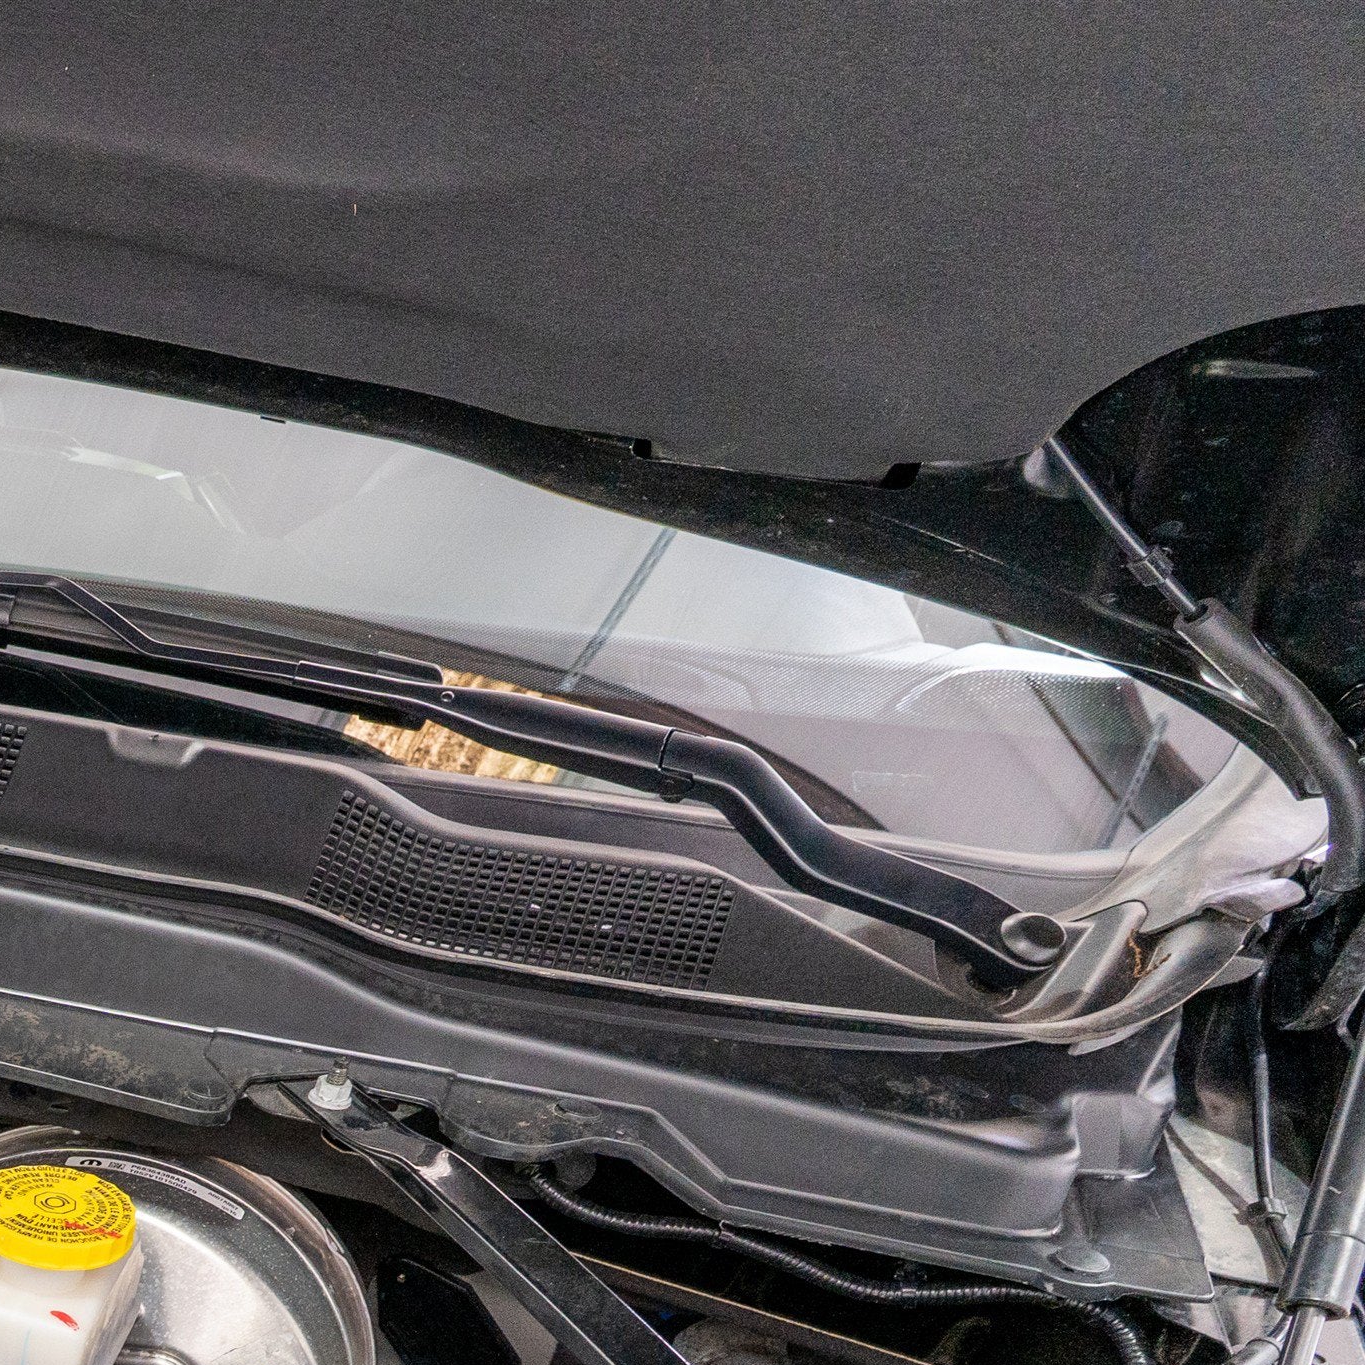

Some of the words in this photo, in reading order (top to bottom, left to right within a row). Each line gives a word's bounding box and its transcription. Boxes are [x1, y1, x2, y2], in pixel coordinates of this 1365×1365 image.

[44, 1172, 78, 1182] BEFORE
[69, 1168, 87, 1178] DOT
[18, 1183, 54, 1197] WARNING
[96, 1179, 113, 1191] MISE
[5, 1216, 58, 1237] UNIQUEMENT
[46, 1236, 58, 1244] DE
[61, 1234, 102, 1244] BOUCHON
